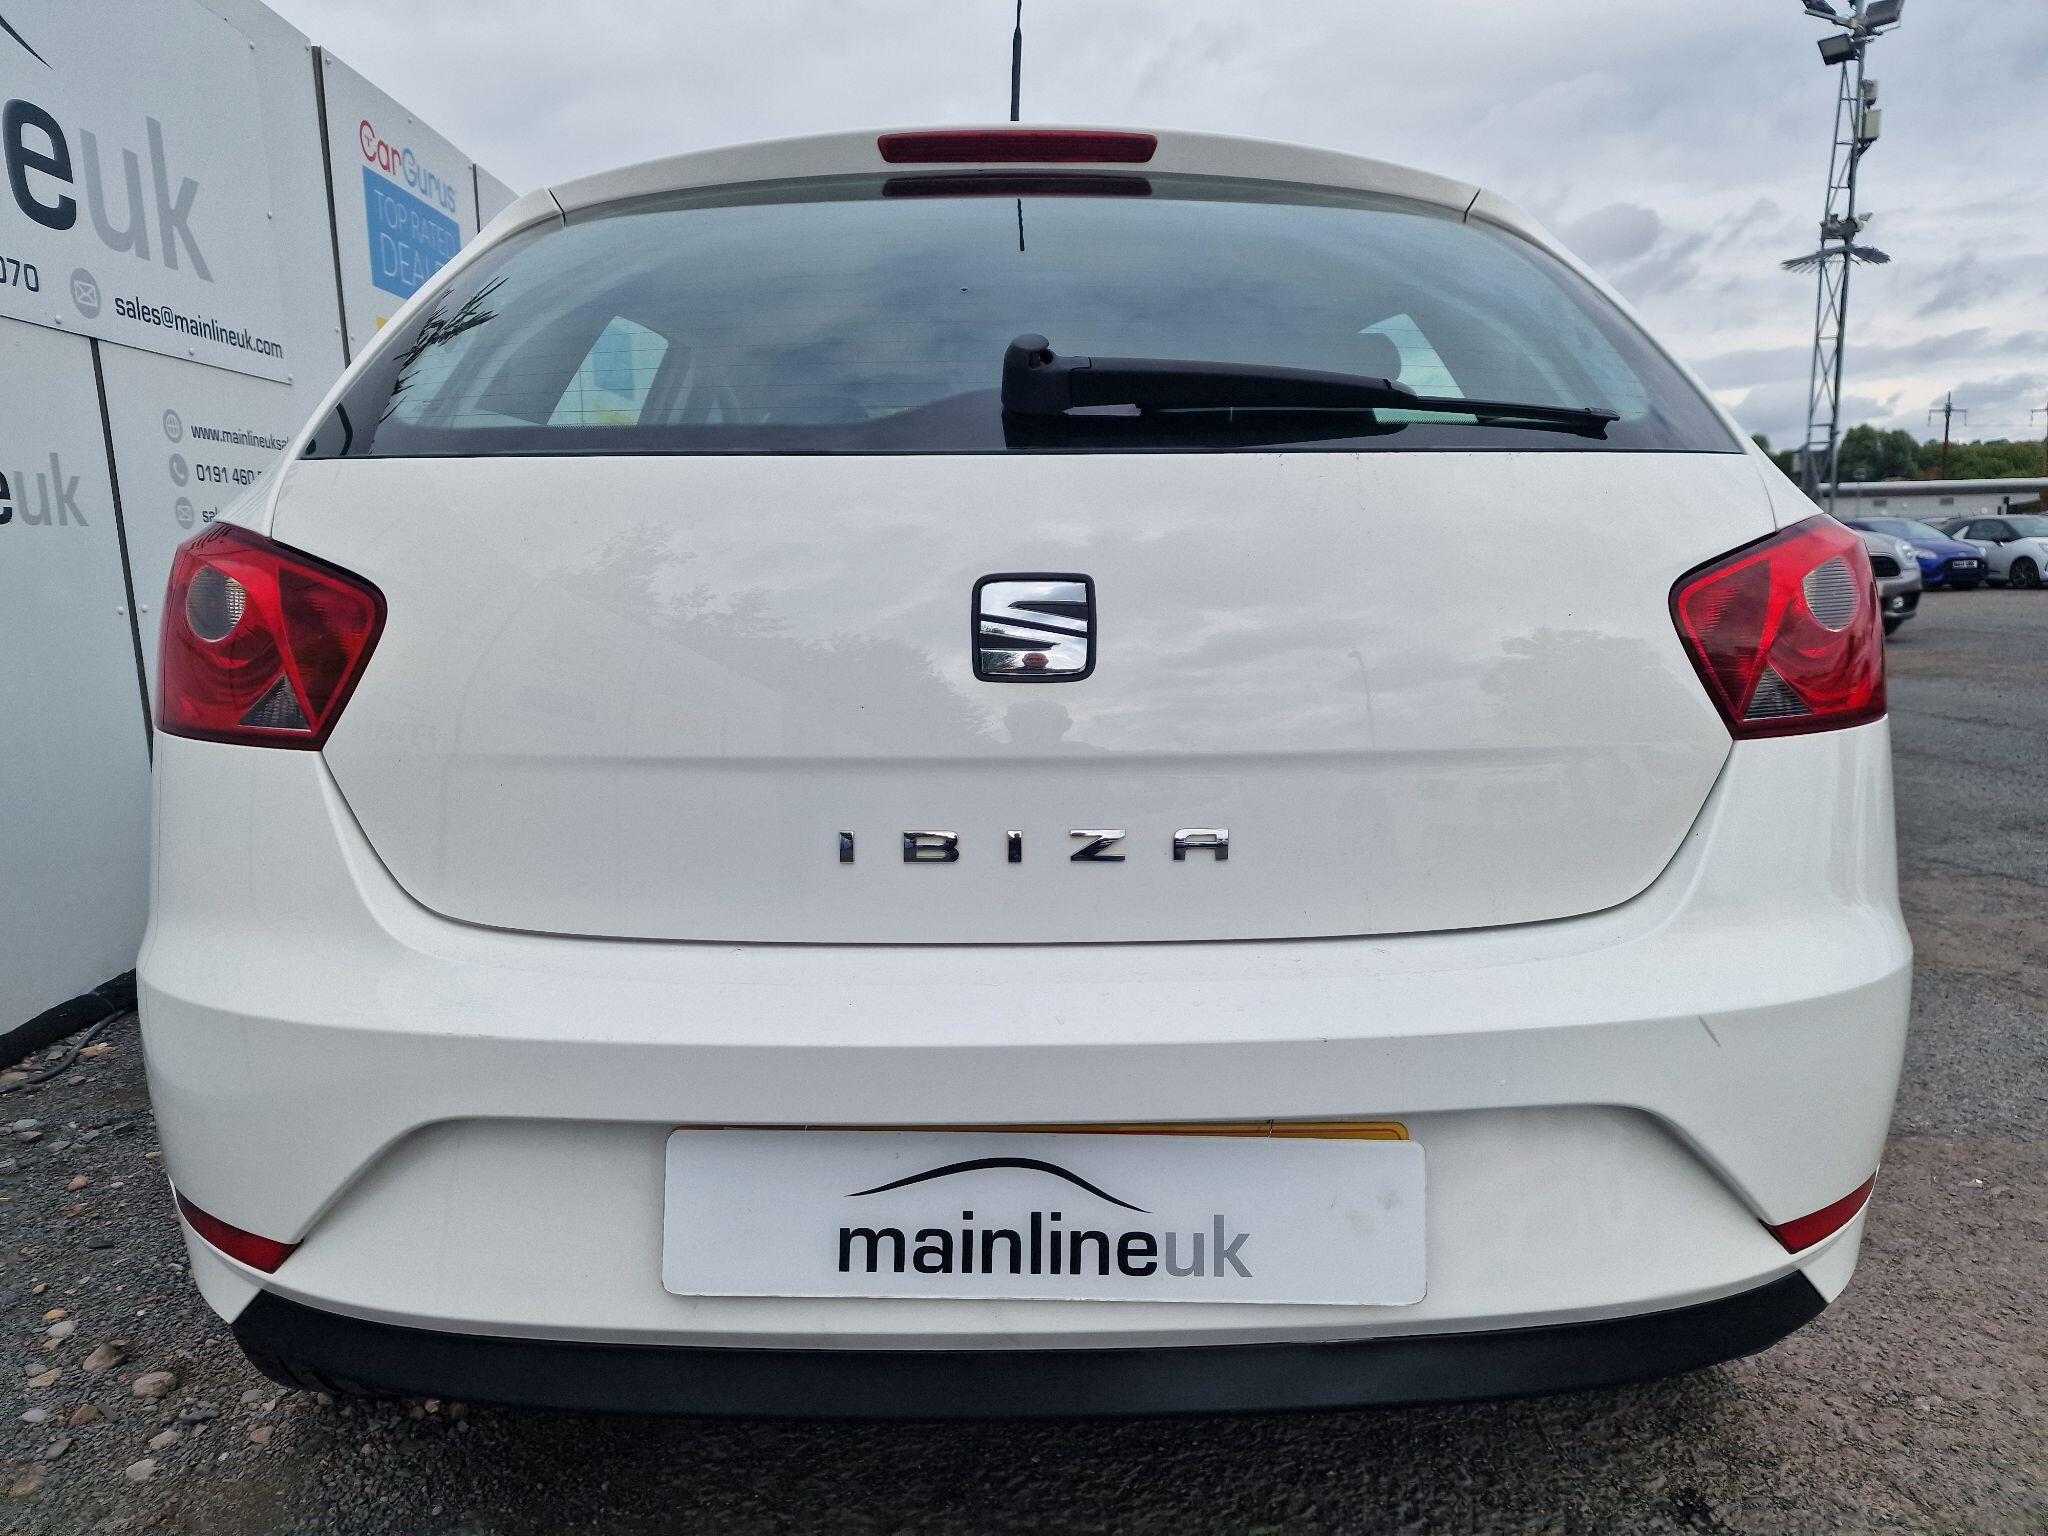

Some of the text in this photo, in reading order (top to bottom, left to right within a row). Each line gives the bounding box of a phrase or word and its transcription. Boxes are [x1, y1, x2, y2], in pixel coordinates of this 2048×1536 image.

[359, 119, 457, 214] CarGurus
[373, 188, 455, 258] TOP RATED
[114, 296, 284, 359] sales@mainlineuk.com
[195, 464, 255, 485] 0191 460
[839, 828, 1230, 864] IBIZA
[838, 1210, 1254, 1278] mainlineuk
